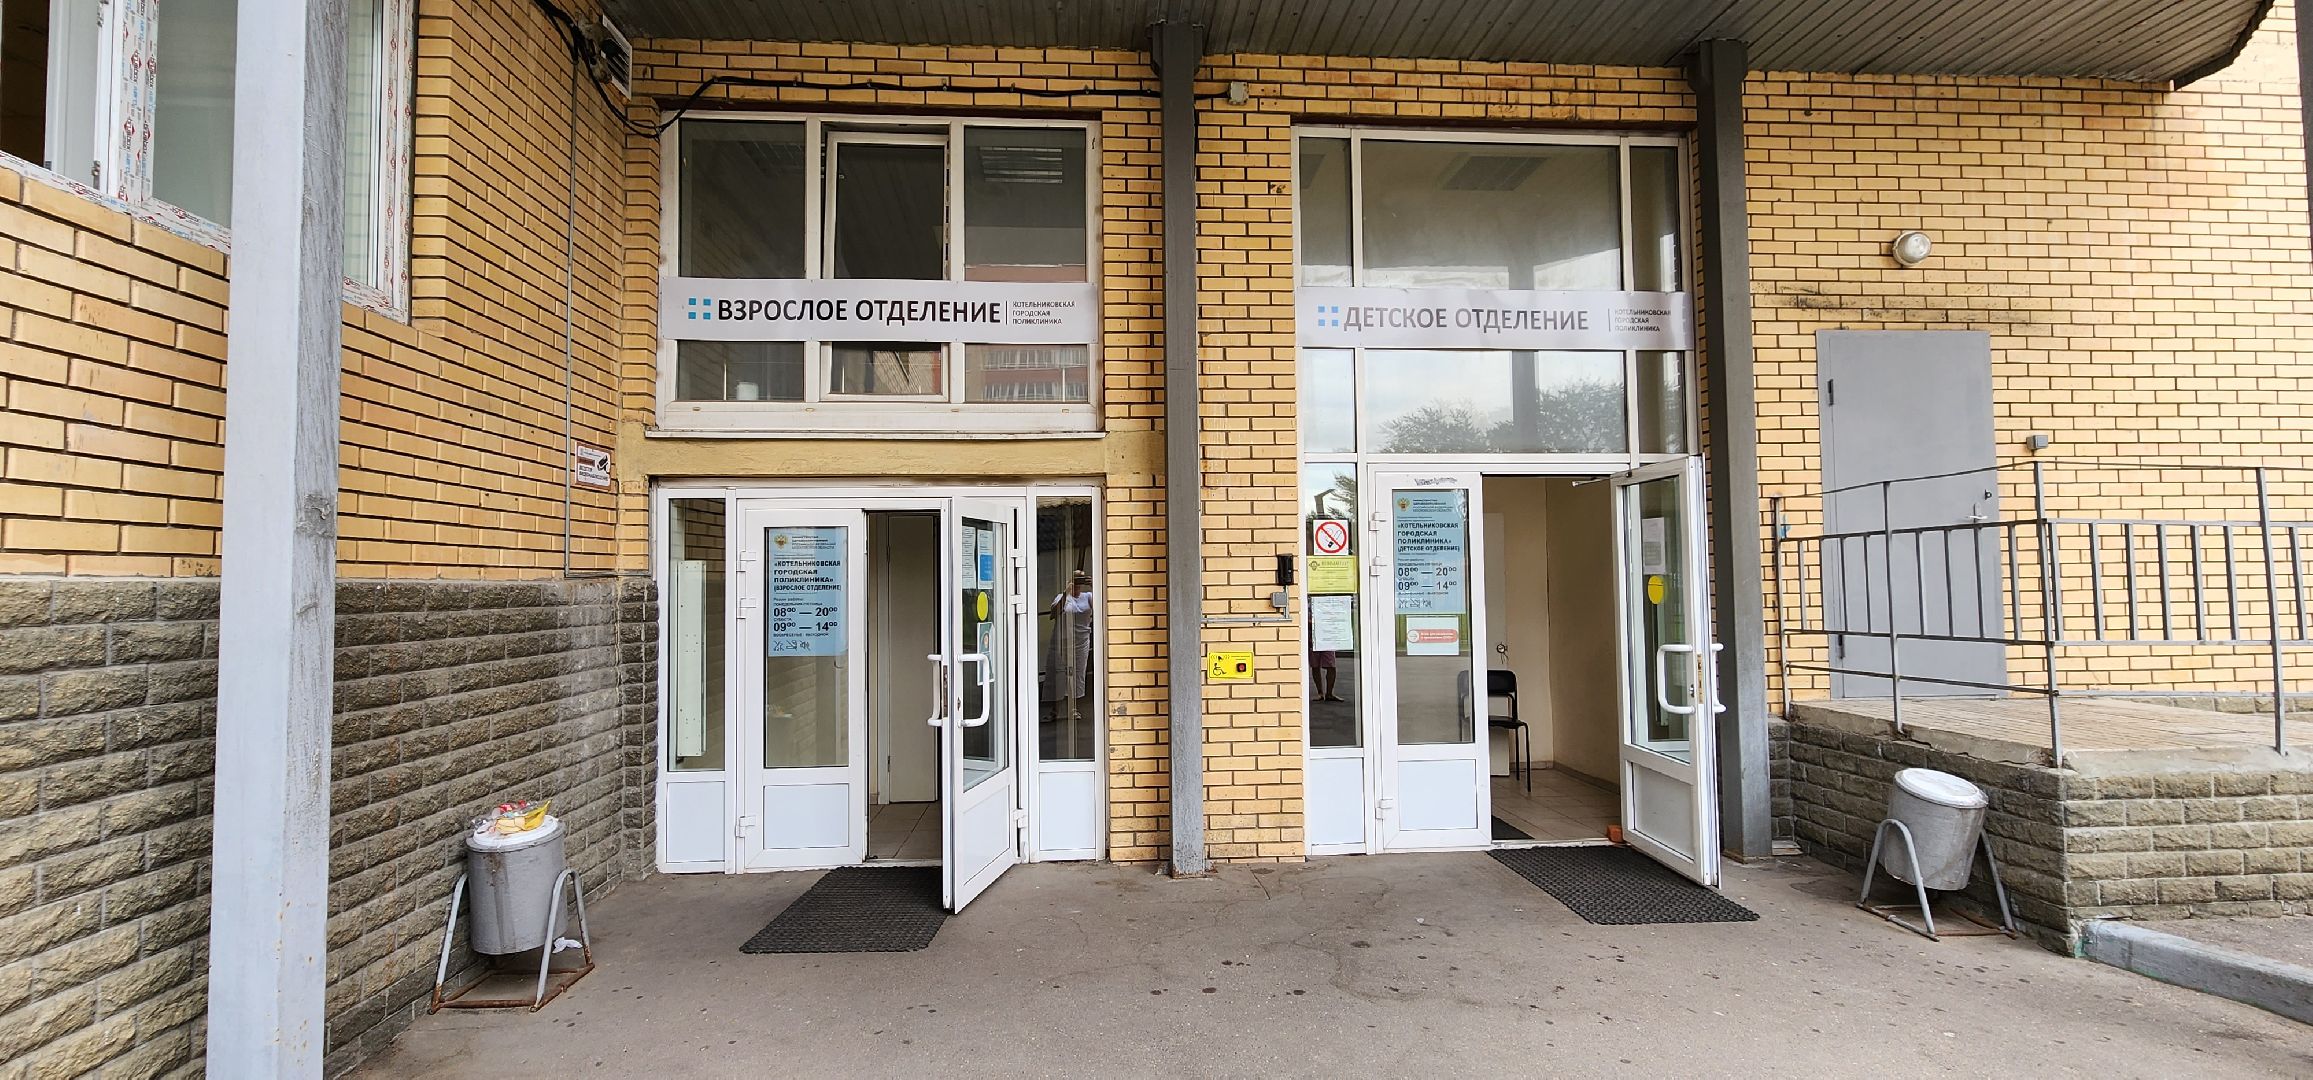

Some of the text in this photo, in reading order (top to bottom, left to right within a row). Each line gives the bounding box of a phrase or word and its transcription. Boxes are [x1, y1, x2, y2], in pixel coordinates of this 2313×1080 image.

[718, 299, 1001, 326] ВЗРОСЛОЕ ОТДЕЛЕНИЕ
[1343, 306, 1589, 334] ДЕТСКОЕ ОТДЕЛЕНИЕ
[1614, 308, 1672, 316] КОТЕЛЬНИКОВСКАЯ
[1397, 530, 1438, 538] ГОРОДСКАЯ
